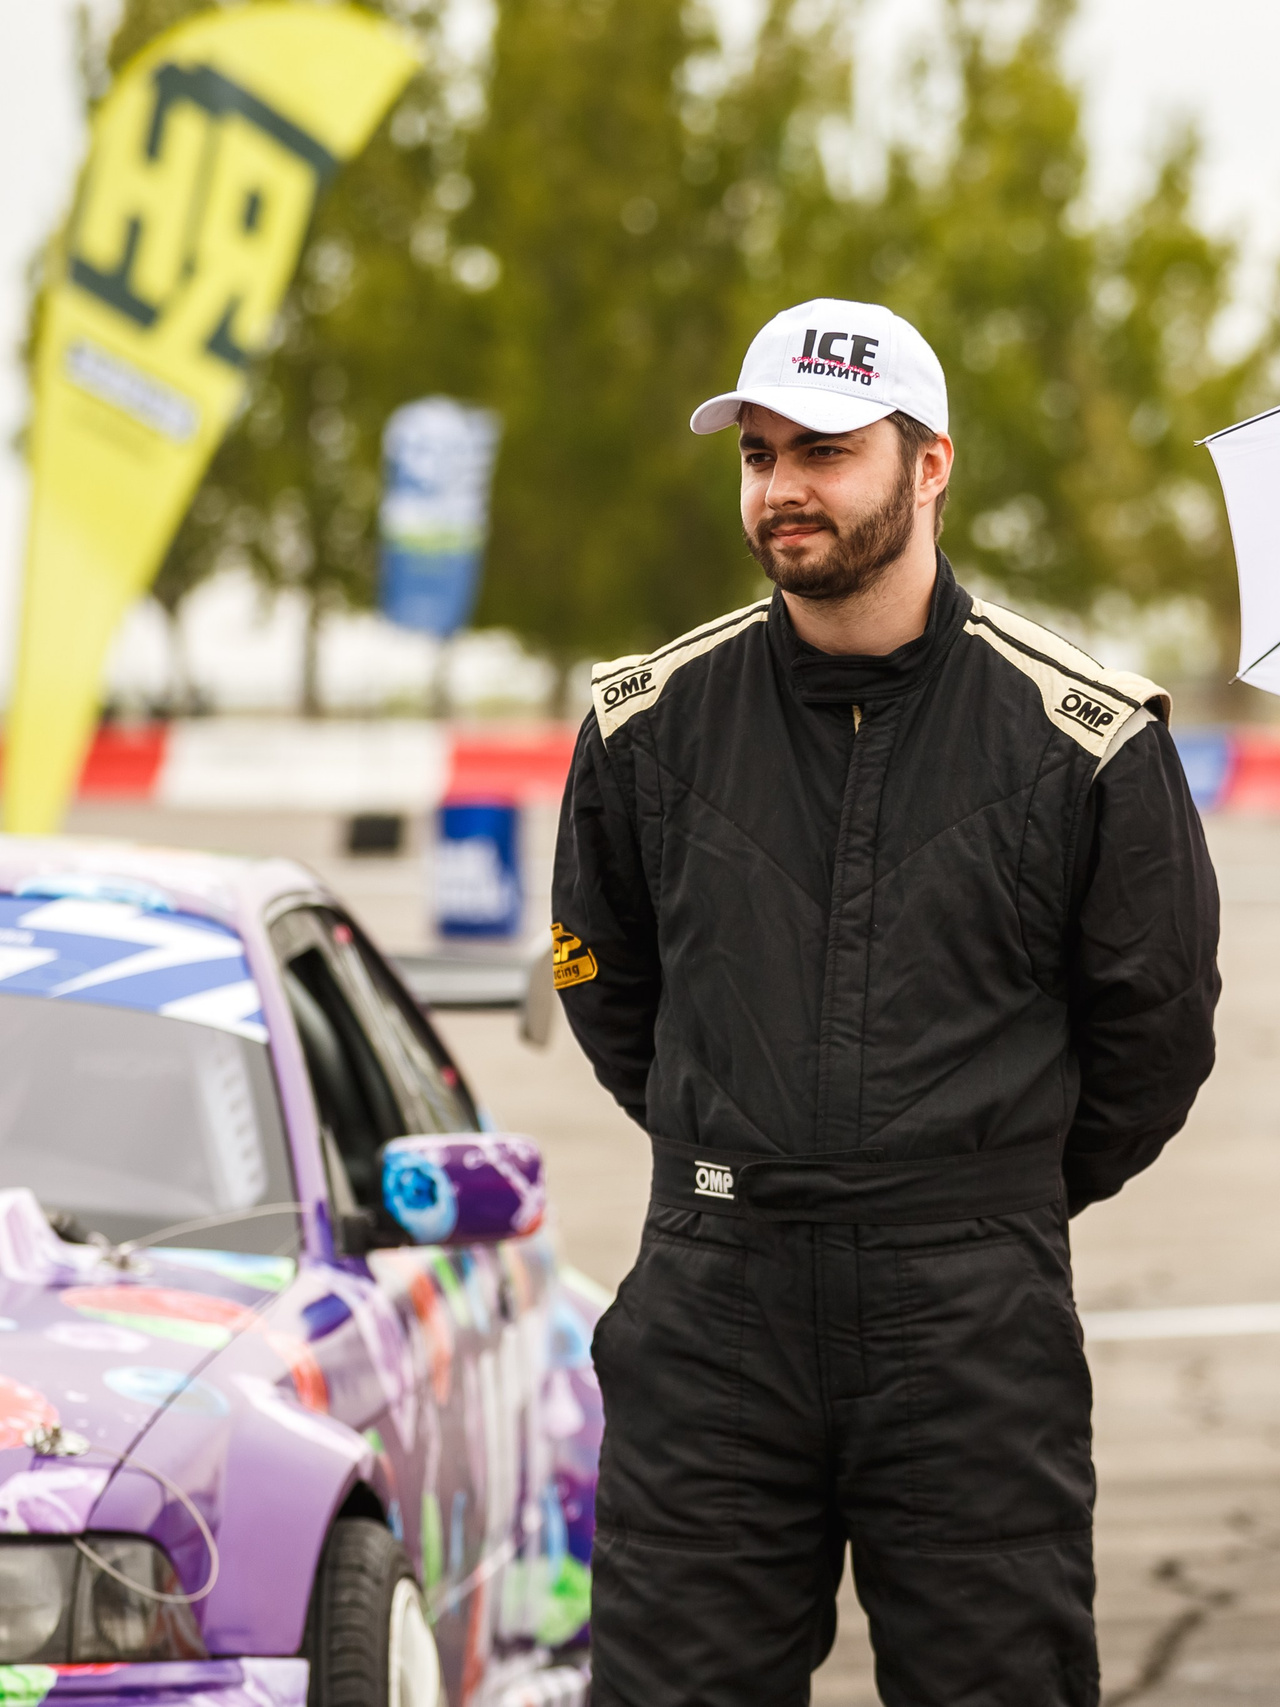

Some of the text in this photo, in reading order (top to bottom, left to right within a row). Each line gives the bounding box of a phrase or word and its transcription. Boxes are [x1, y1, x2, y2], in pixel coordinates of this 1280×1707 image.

[802, 329, 879, 373] ICE
[797, 361, 872, 386] МОХИТО
[603, 672, 652, 705] OMP
[1061, 693, 1114, 729] OMP
[695, 1167, 734, 1194] OMP
